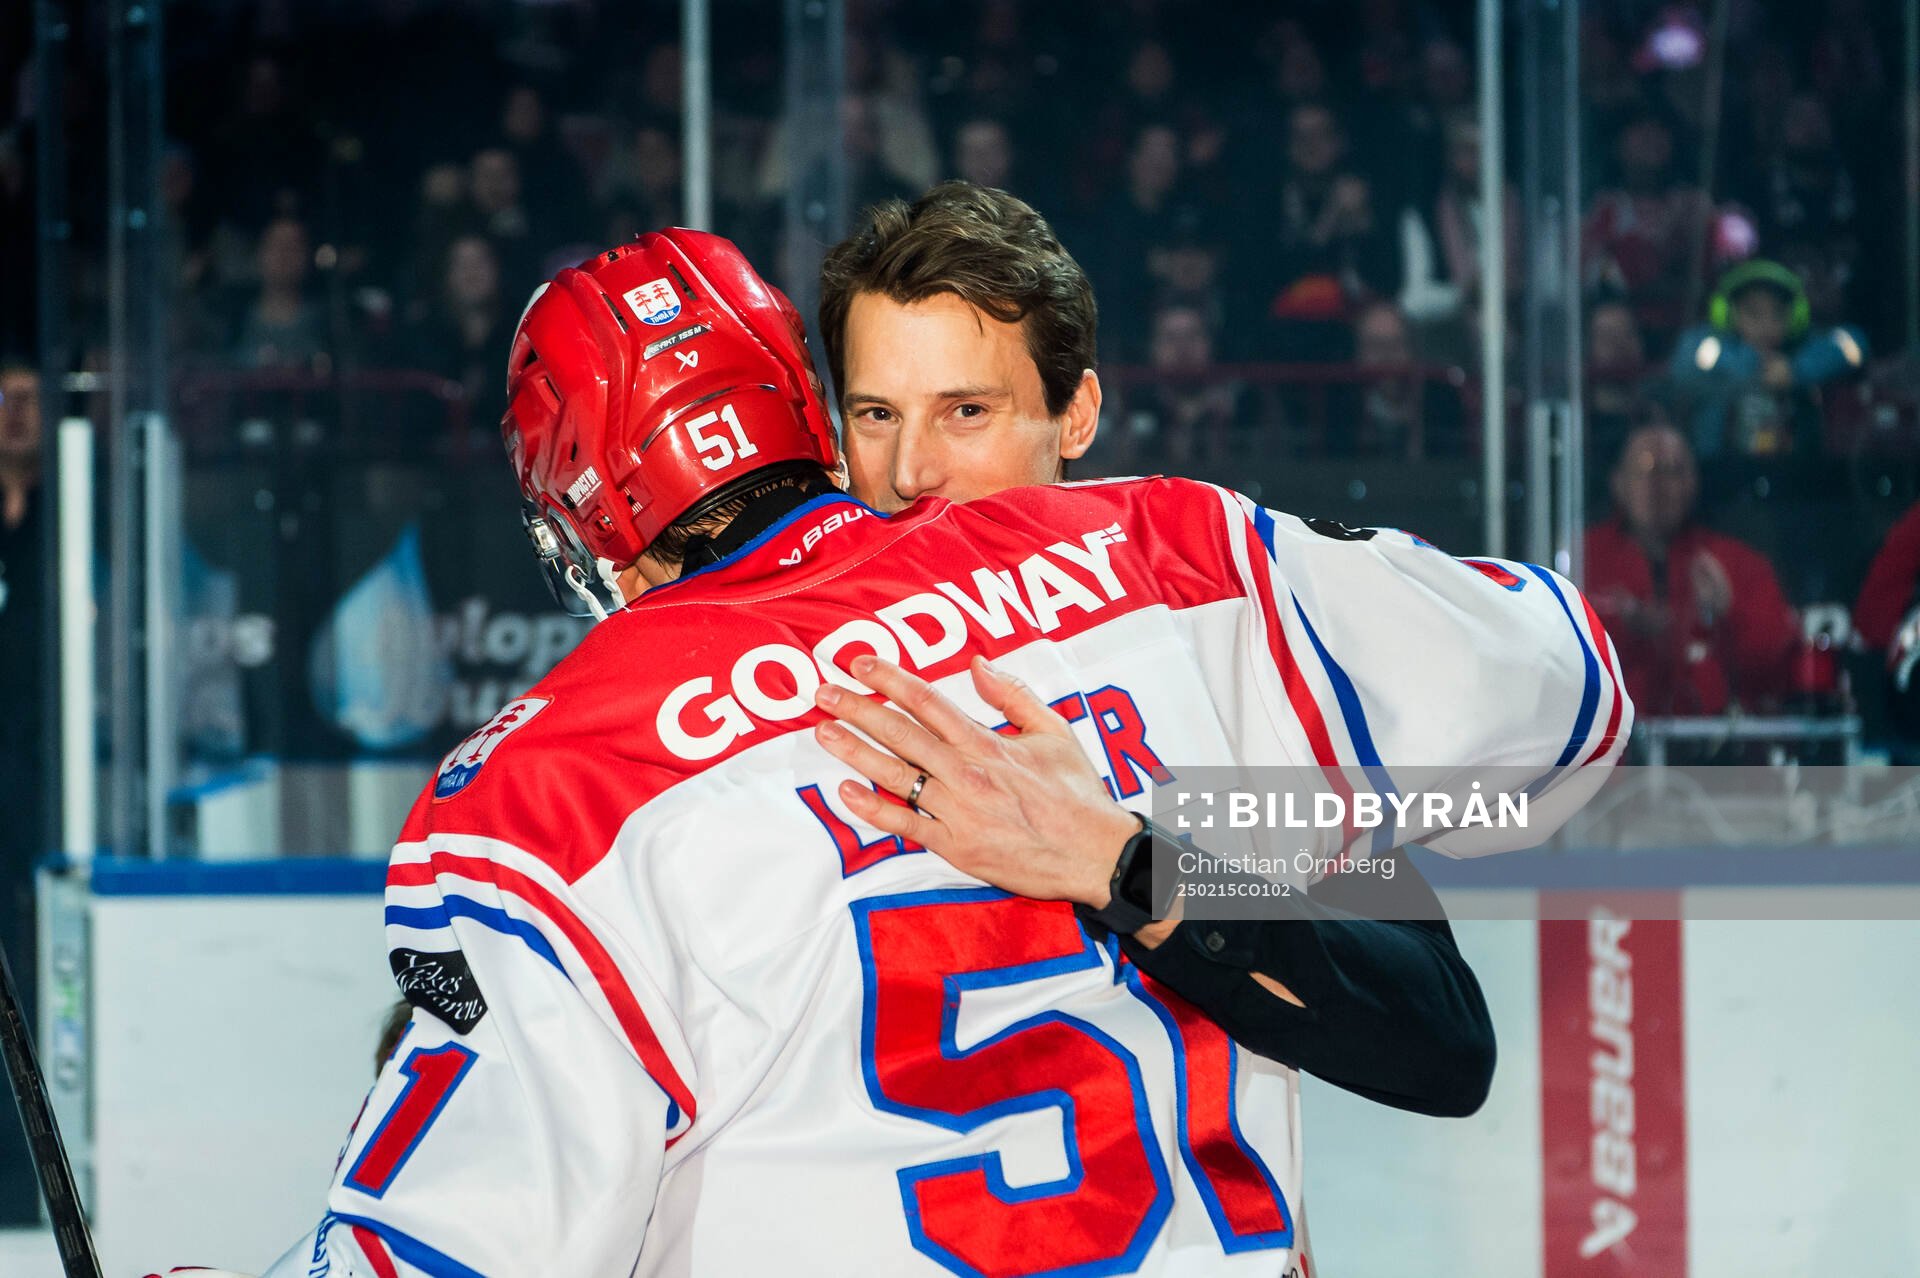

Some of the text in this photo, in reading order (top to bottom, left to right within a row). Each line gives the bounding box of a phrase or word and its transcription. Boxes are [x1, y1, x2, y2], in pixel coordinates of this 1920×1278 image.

[693, 326, 701, 334] M
[685, 403, 758, 471] 51
[656, 522, 1128, 761] GOODWAY
[850, 886, 1294, 1278] 51
